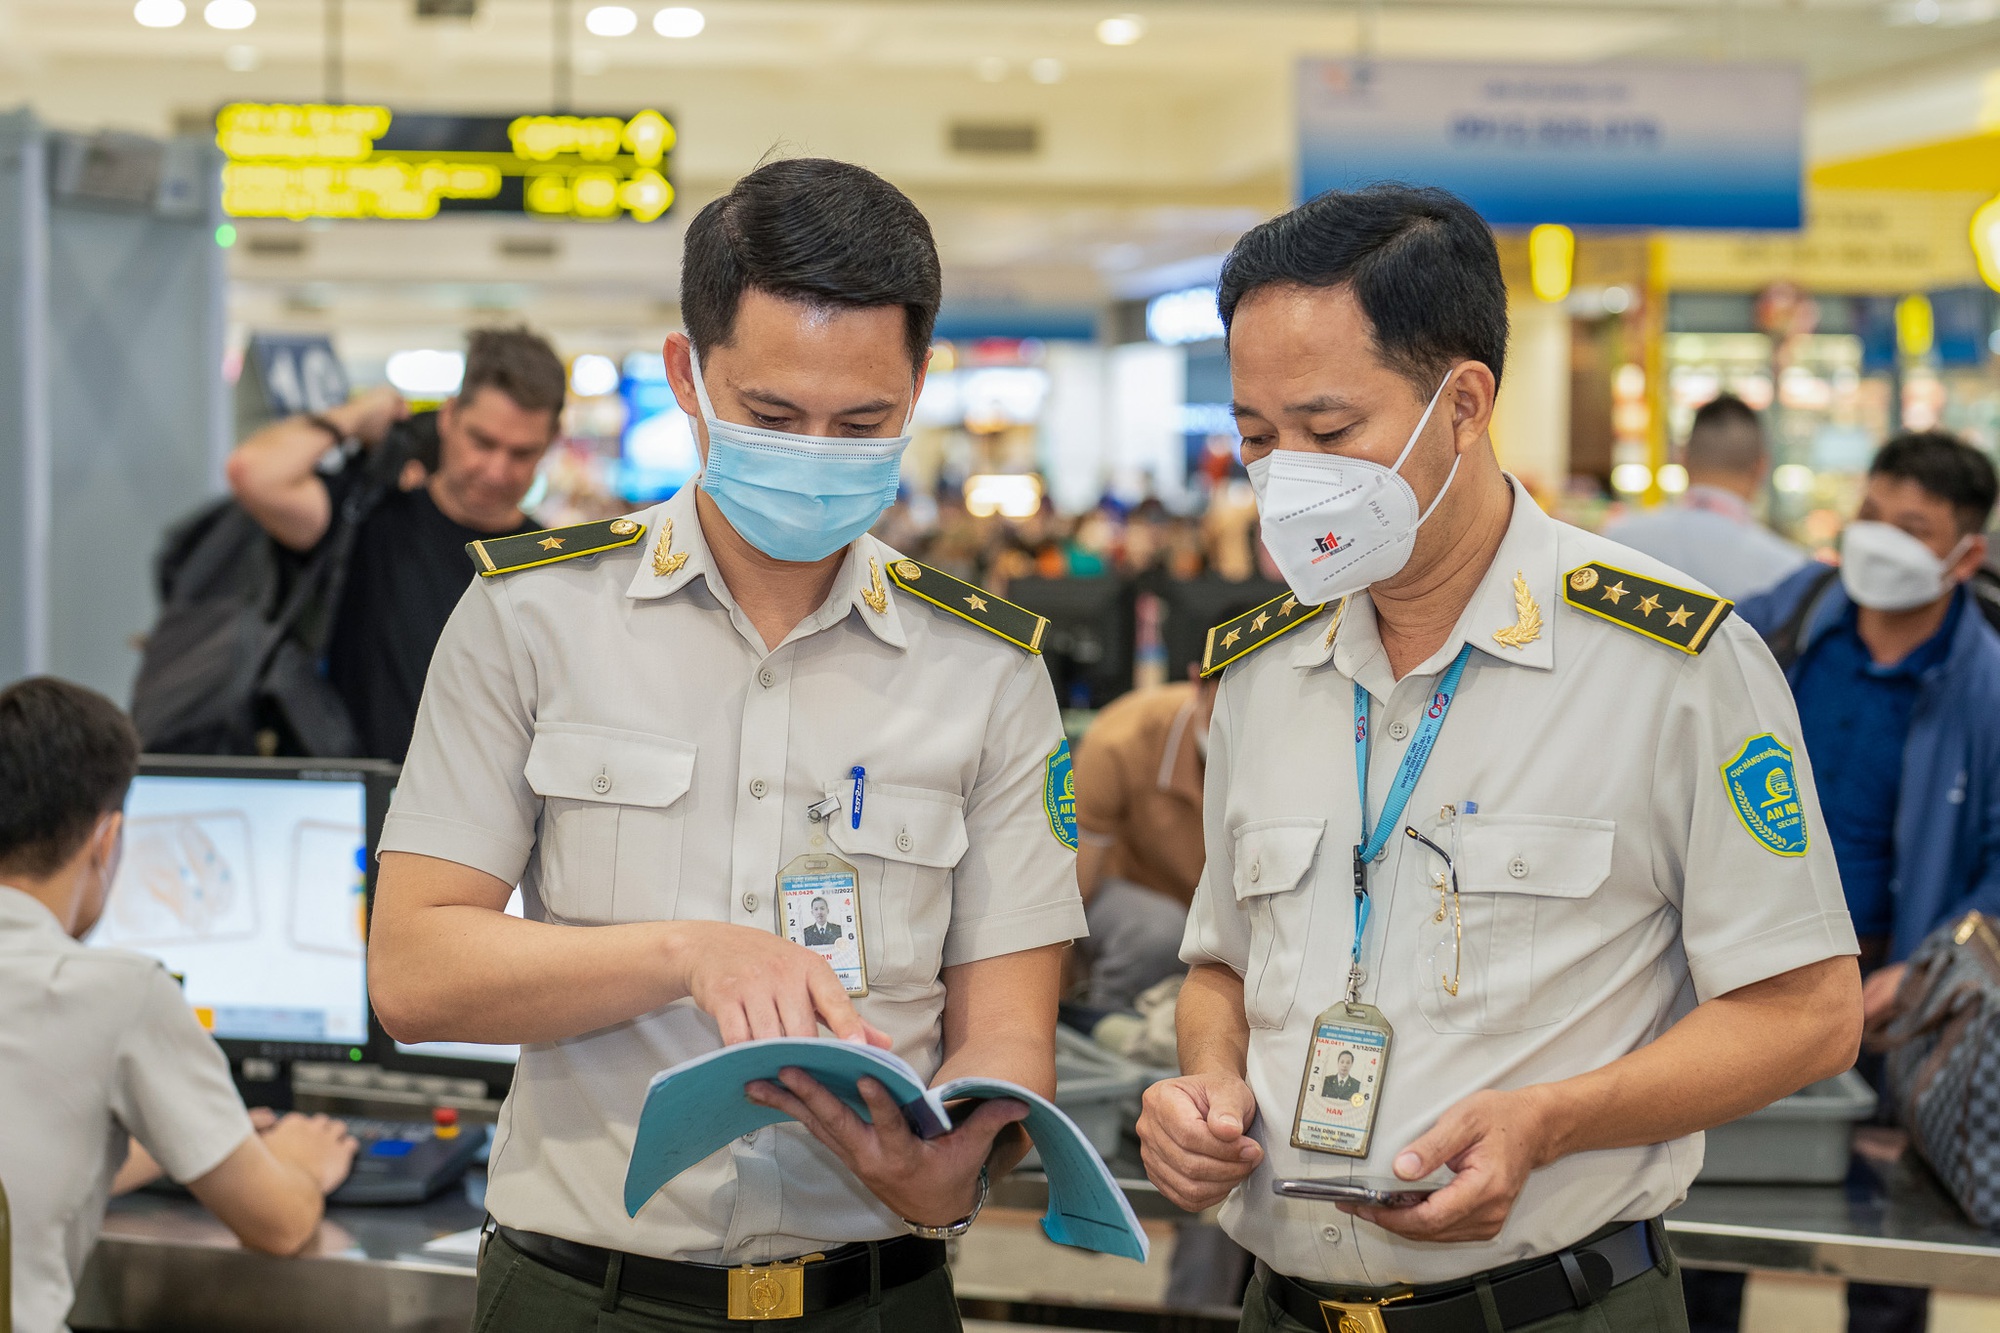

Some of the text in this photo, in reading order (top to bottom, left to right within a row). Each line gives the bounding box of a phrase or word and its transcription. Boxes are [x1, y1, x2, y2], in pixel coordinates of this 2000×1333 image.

[1368, 500, 1390, 527] PM2.5
[1060, 803, 1070, 815] AN
[1767, 806, 1784, 822] AN
[787, 902, 792, 910] 1
[844, 898, 851, 906] 4
[1370, 1058, 1376, 1066] 4
[1313, 1066, 1319, 1074] 2
[1367, 1075, 1373, 1083] 5
[1309, 1084, 1315, 1092] 3
[1364, 1093, 1370, 1101] 6
[1326, 1107, 1344, 1116] HAN
[1337, 1130, 1355, 1138] TRUNG
